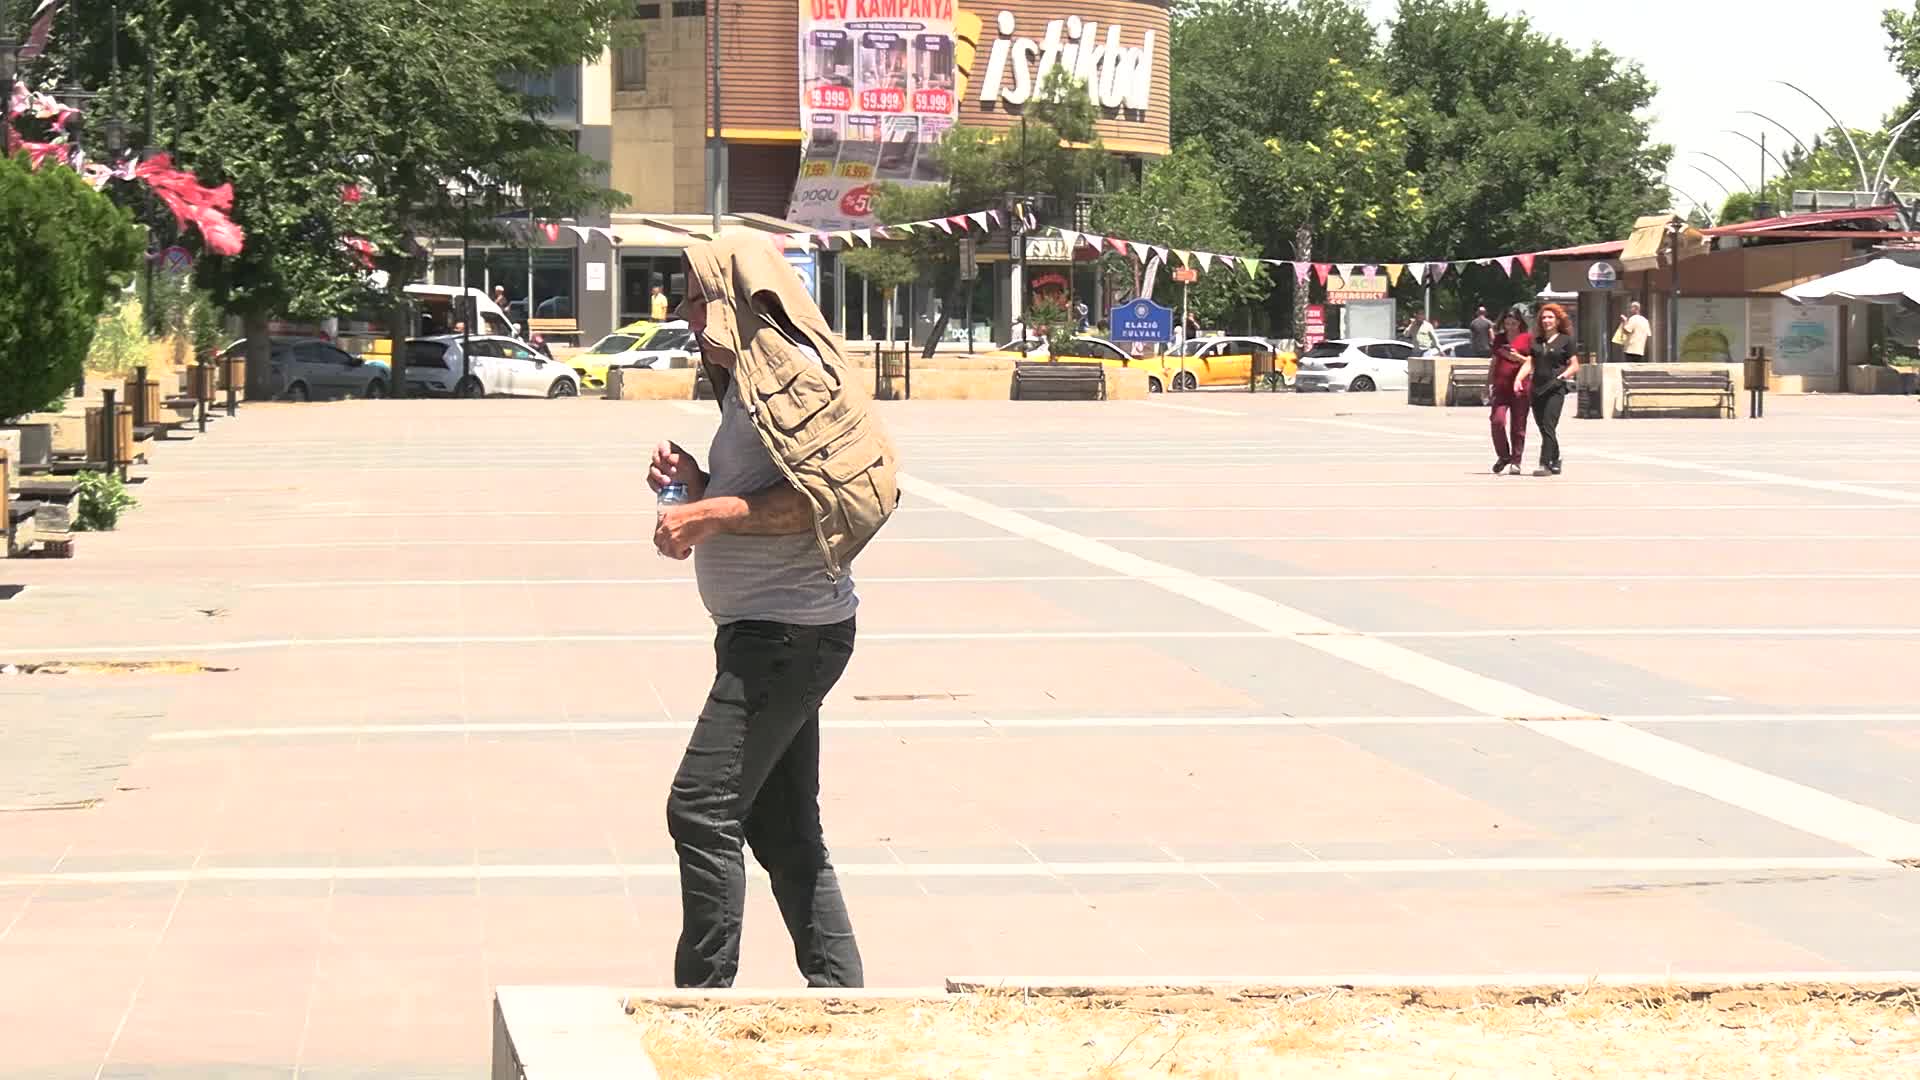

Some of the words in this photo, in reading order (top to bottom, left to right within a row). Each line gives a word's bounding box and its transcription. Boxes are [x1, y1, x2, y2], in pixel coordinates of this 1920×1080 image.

[811, 0, 848, 19] DEV
[856, 0, 953, 19] KAMPANYA
[980, 10, 1155, 109] istikbal
